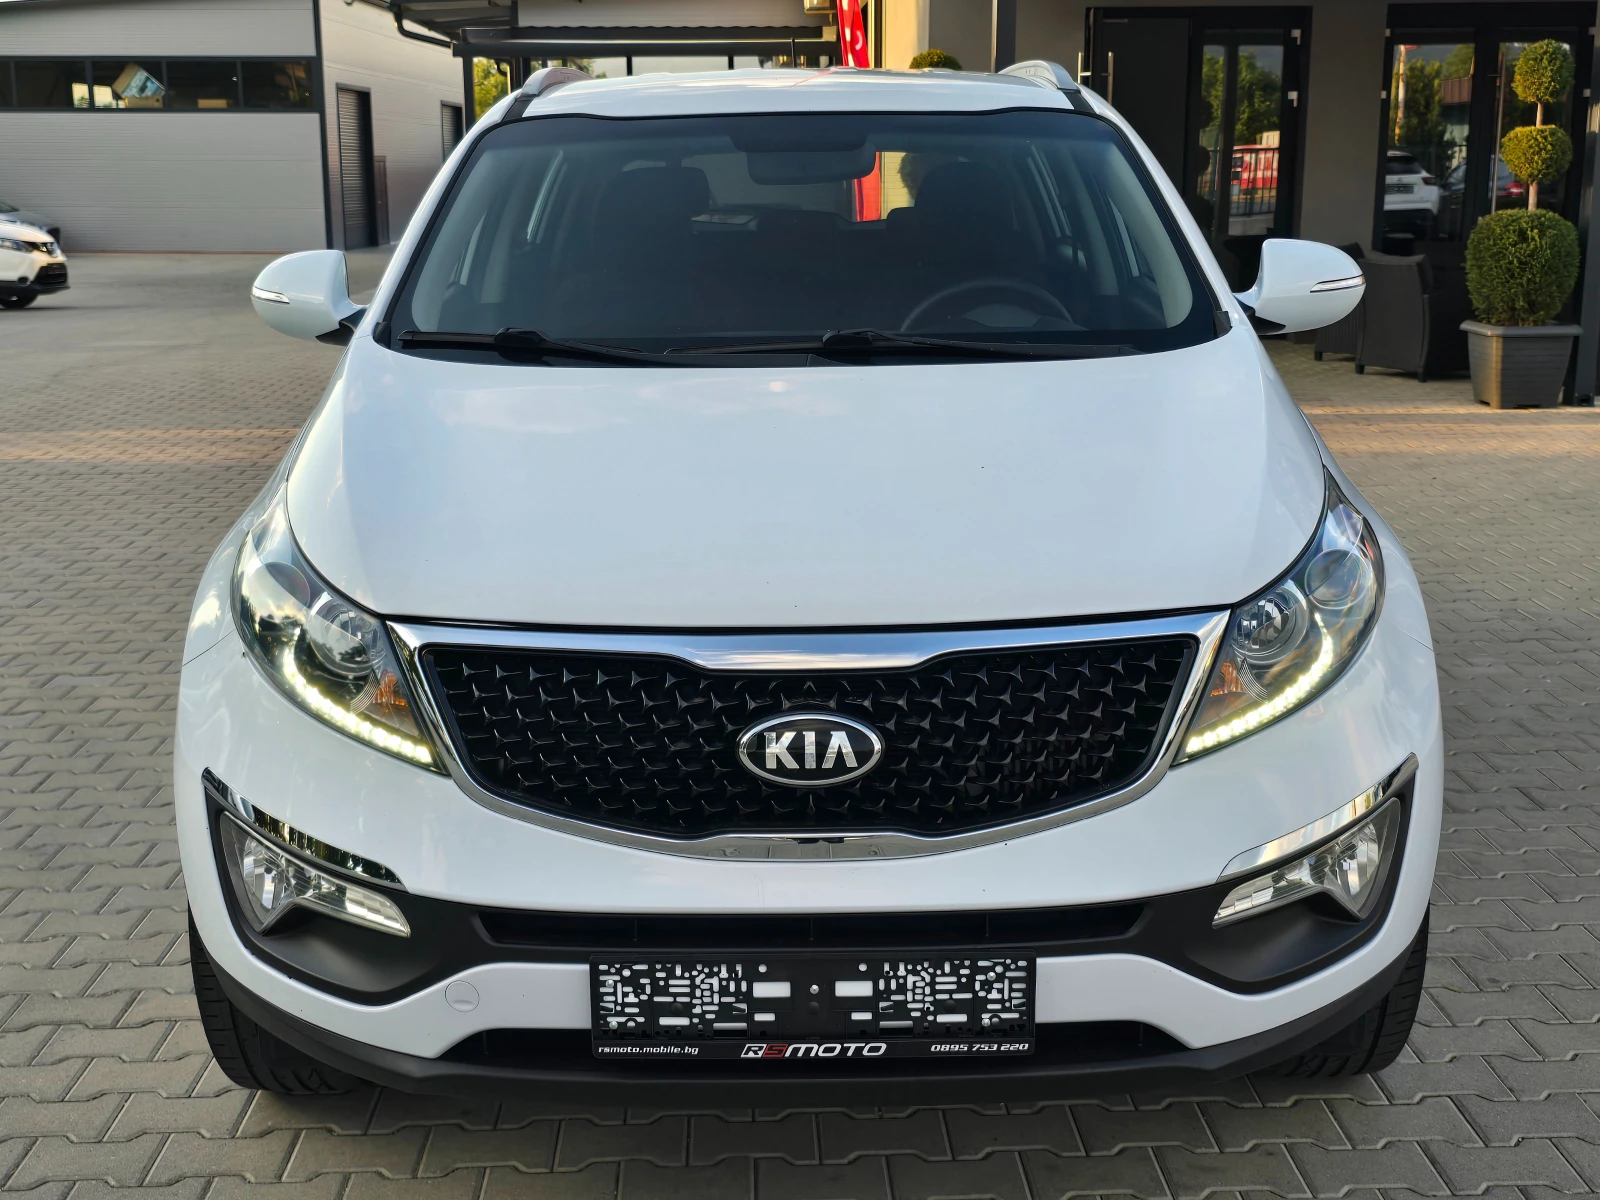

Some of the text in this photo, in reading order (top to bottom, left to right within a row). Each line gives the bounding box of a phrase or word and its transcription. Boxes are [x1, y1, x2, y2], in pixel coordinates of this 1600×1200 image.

[764, 731, 858, 769] KIA
[598, 1046, 699, 1055] rsmoto.mobile.bg
[740, 1042, 887, 1058] RSMOTO
[930, 1043, 1029, 1052] 0895 753 220
